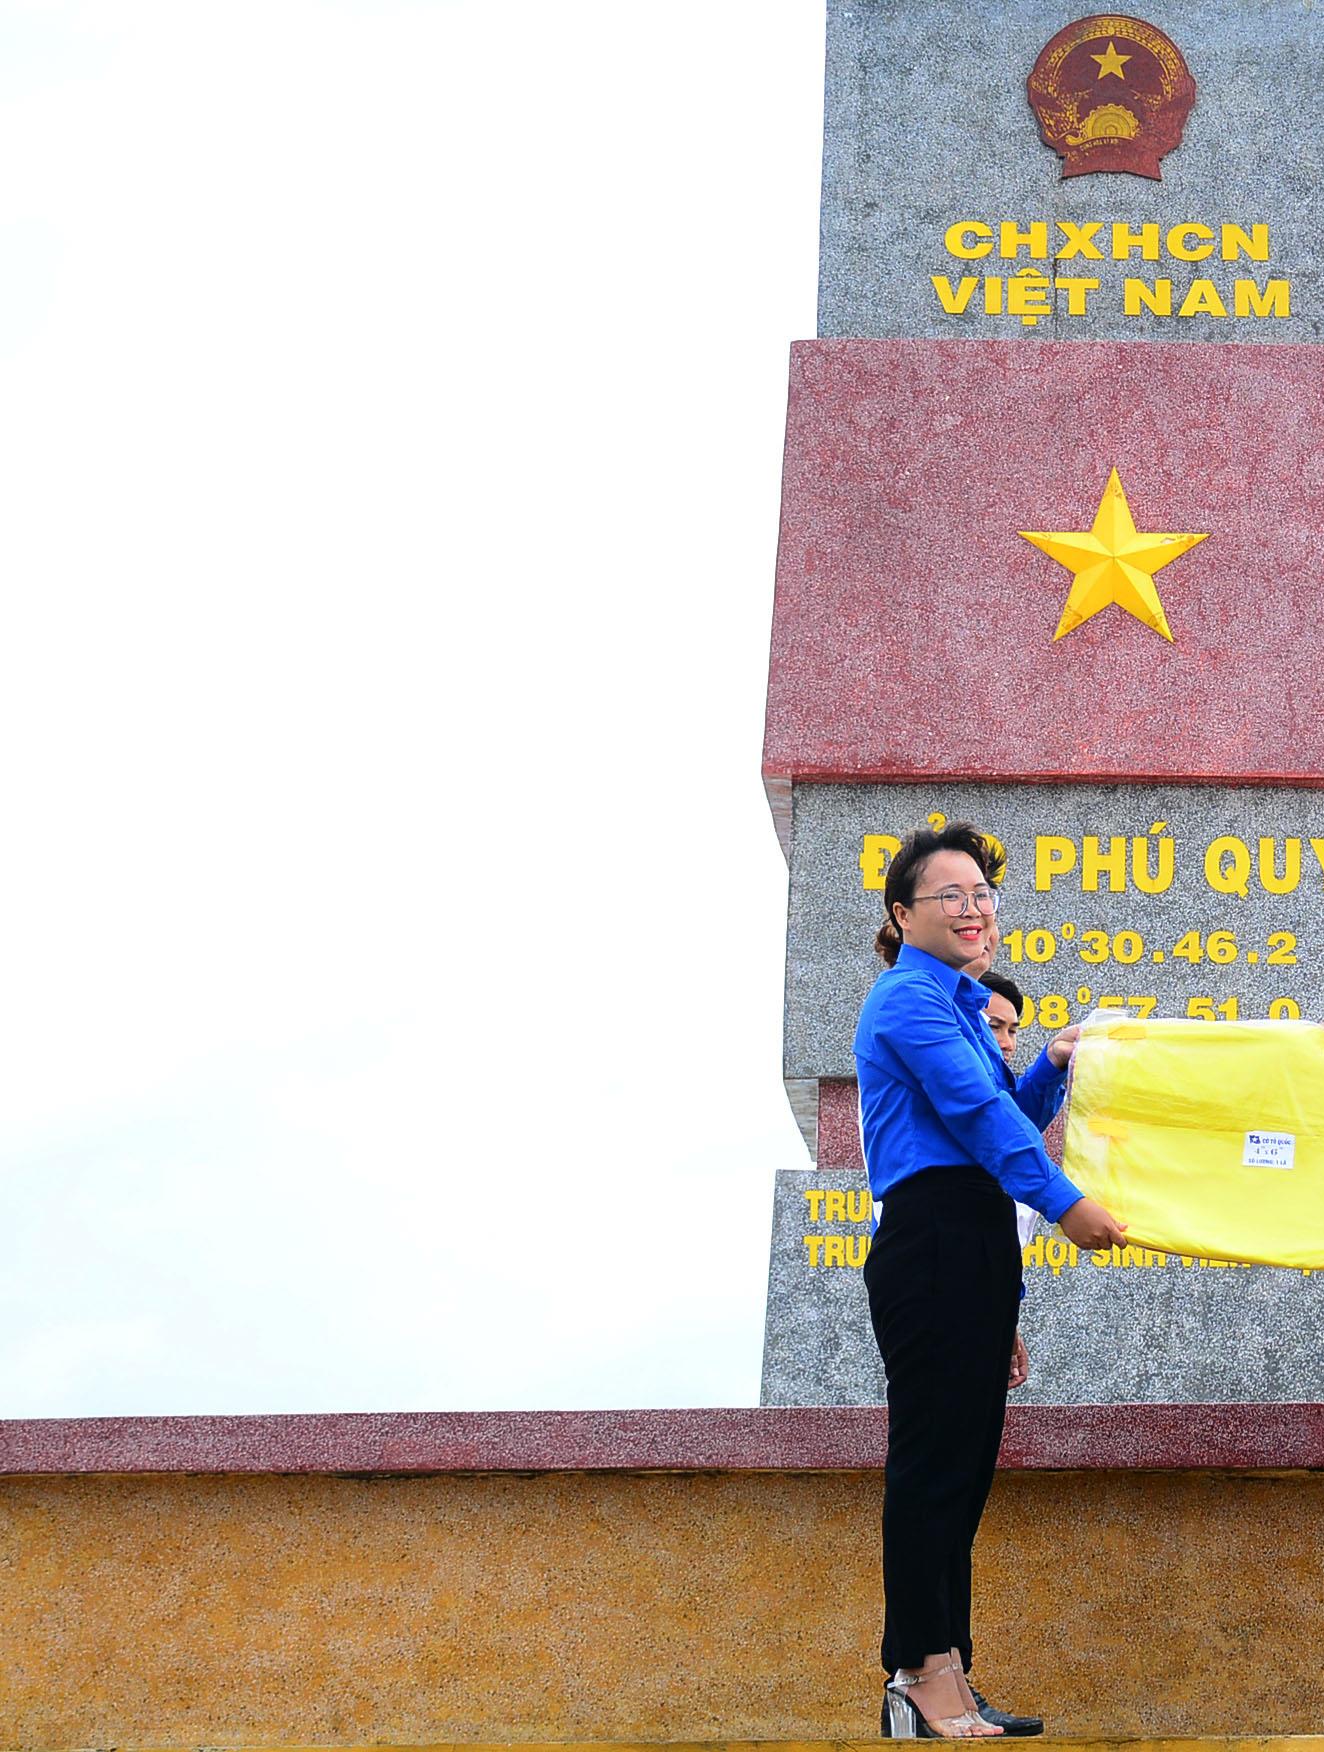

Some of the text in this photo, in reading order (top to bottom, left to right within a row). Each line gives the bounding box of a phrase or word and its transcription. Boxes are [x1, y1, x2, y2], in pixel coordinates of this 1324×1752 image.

[944, 220, 1269, 261] CHXHCN
[931, 267, 1291, 326] VIỆT NAM
[1035, 821, 1175, 894] PHÚ
